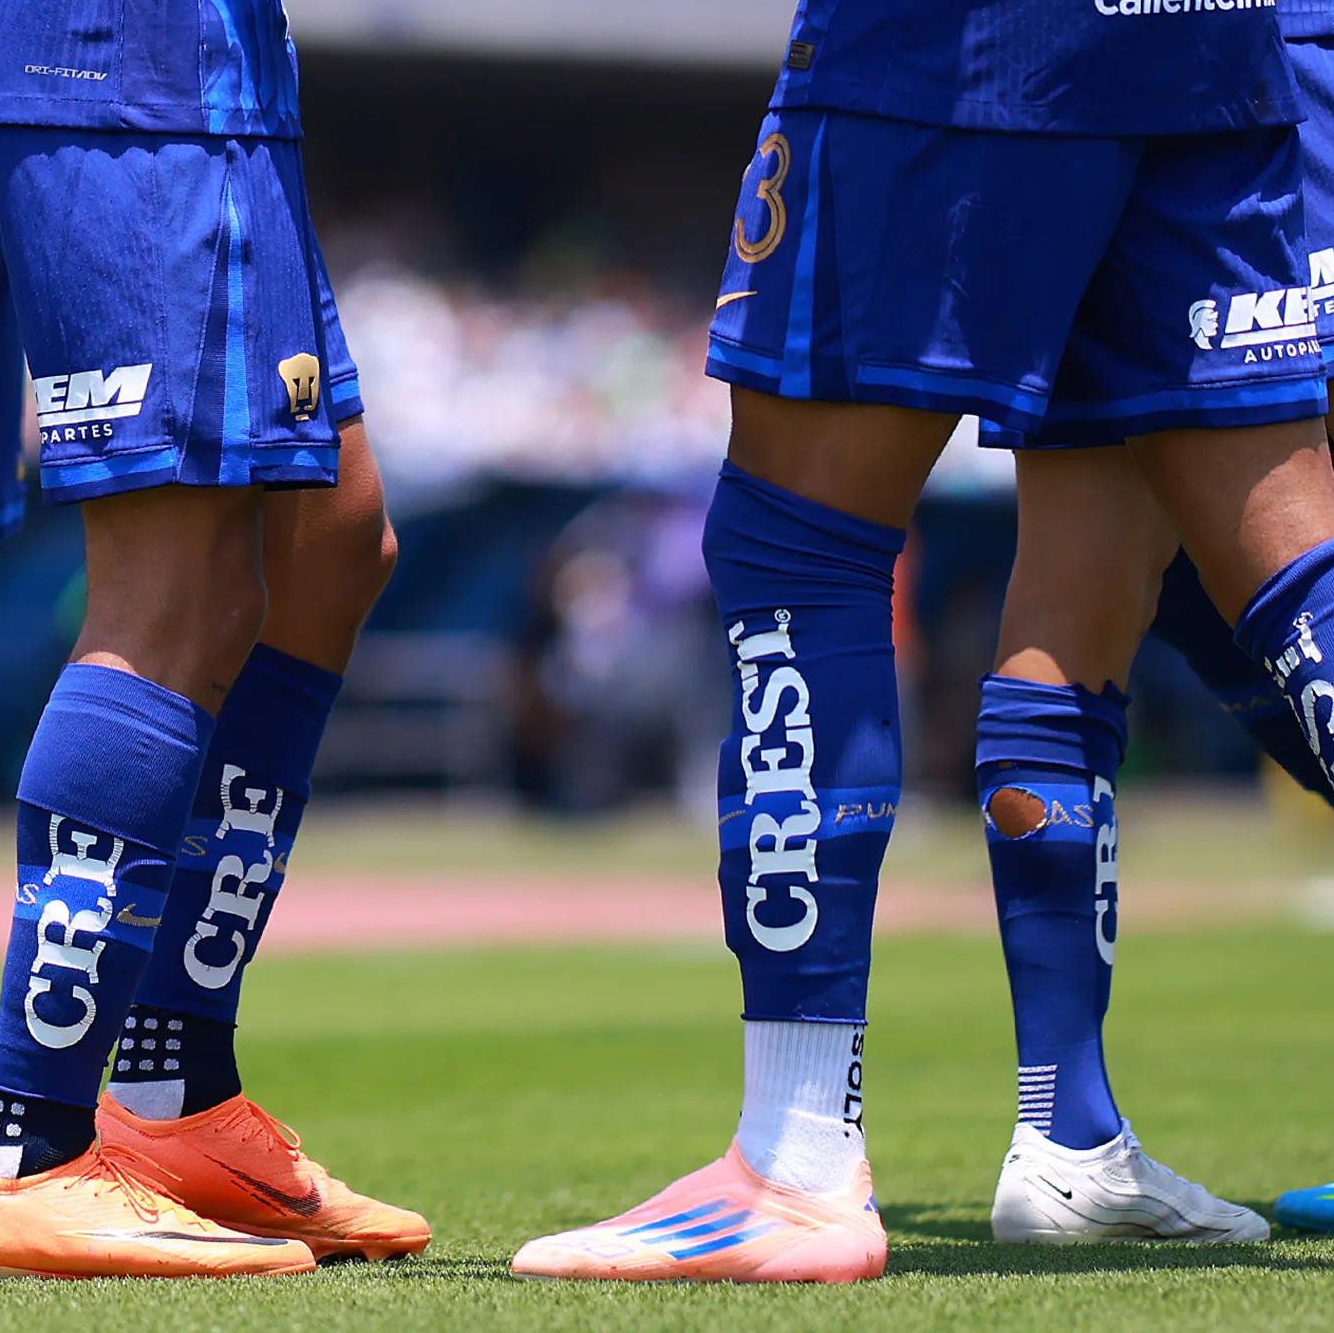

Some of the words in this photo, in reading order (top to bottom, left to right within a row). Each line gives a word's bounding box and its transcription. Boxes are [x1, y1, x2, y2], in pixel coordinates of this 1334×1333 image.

[734, 132, 791, 264] 3
[23, 812, 125, 1050] CRE
[183, 763, 284, 990] CRE
